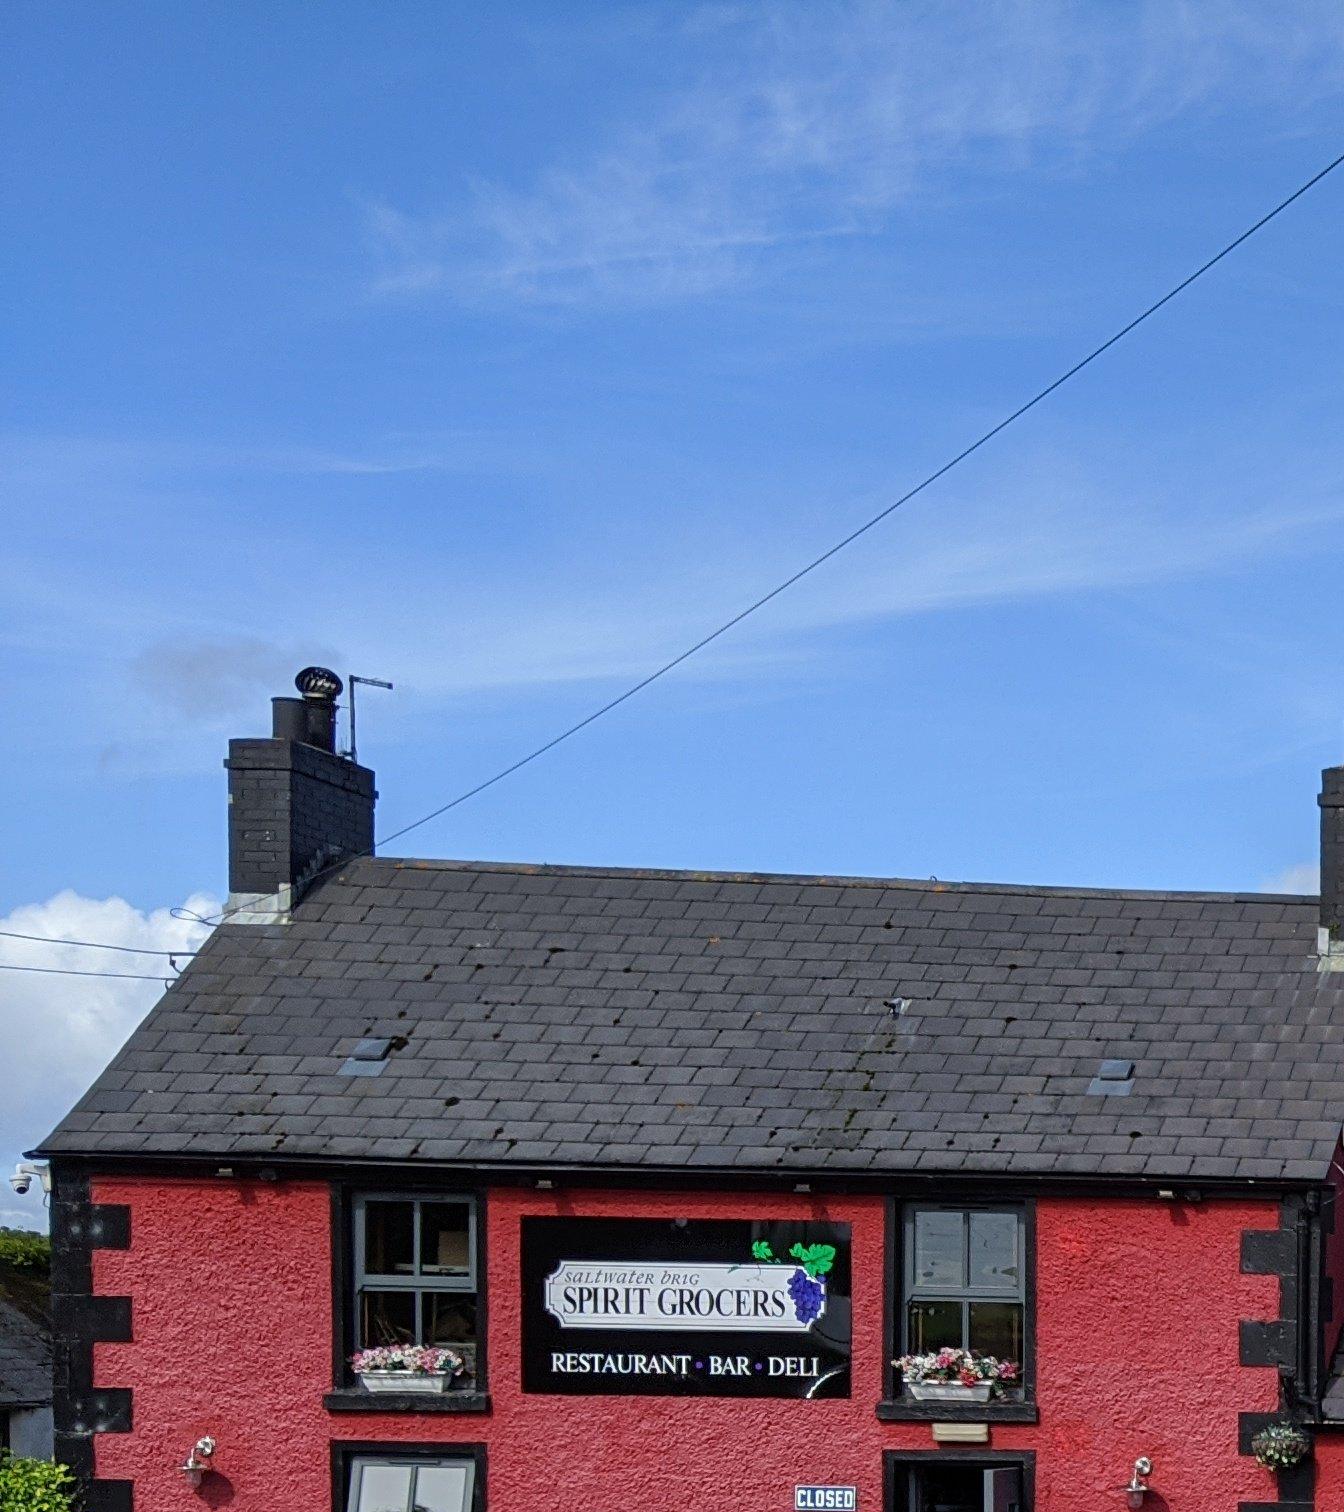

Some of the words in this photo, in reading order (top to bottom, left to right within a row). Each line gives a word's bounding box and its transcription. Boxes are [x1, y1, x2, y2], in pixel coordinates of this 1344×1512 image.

[562, 1285, 651, 1315] SPIRIT
[657, 1287, 786, 1318] GROCERS
[551, 1352, 692, 1376] RESTAURANT
[709, 1355, 752, 1376] BAR
[767, 1356, 820, 1377] DELI
[797, 1489, 854, 1508] CLOSED
